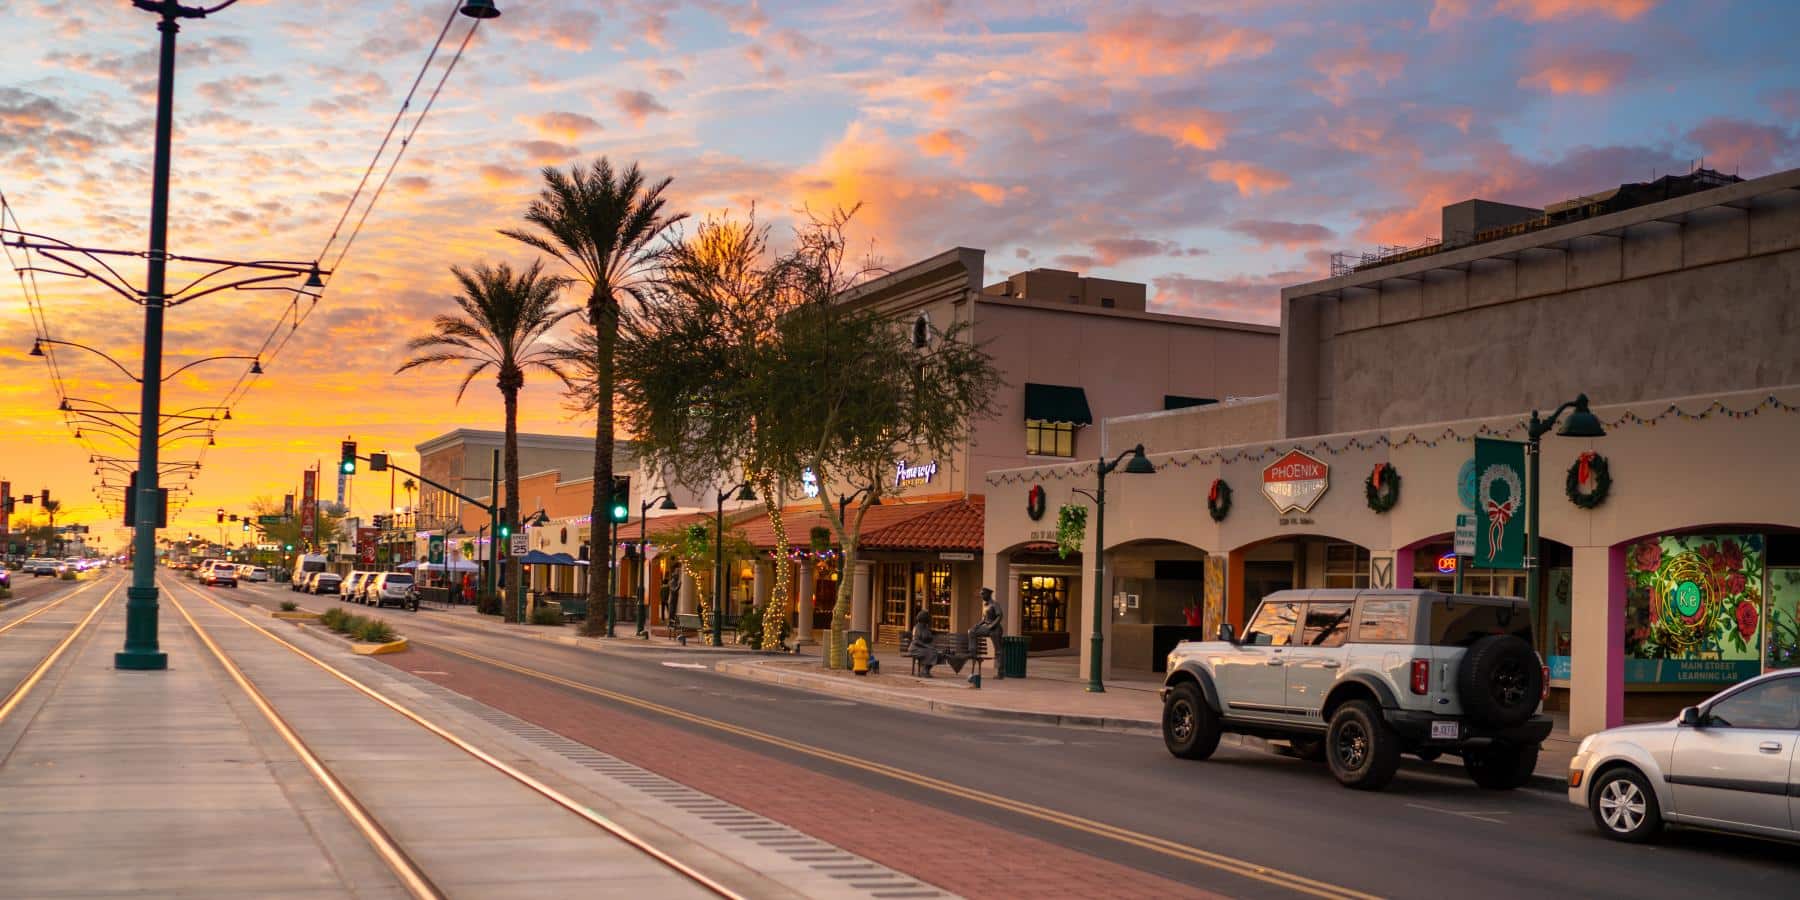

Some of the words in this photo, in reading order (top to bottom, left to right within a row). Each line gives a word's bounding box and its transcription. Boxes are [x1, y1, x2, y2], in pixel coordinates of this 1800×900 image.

[896, 461, 936, 487] Pomeroy's
[1272, 463, 1318, 479] PHOENIX
[513, 545, 527, 554] 25
[1439, 558, 1456, 570] OPE
[1681, 662, 1704, 670] MAIN
[1705, 662, 1736, 670] STREET
[1678, 671, 1720, 680] LEARNING
[1721, 671, 1738, 680] LAB
